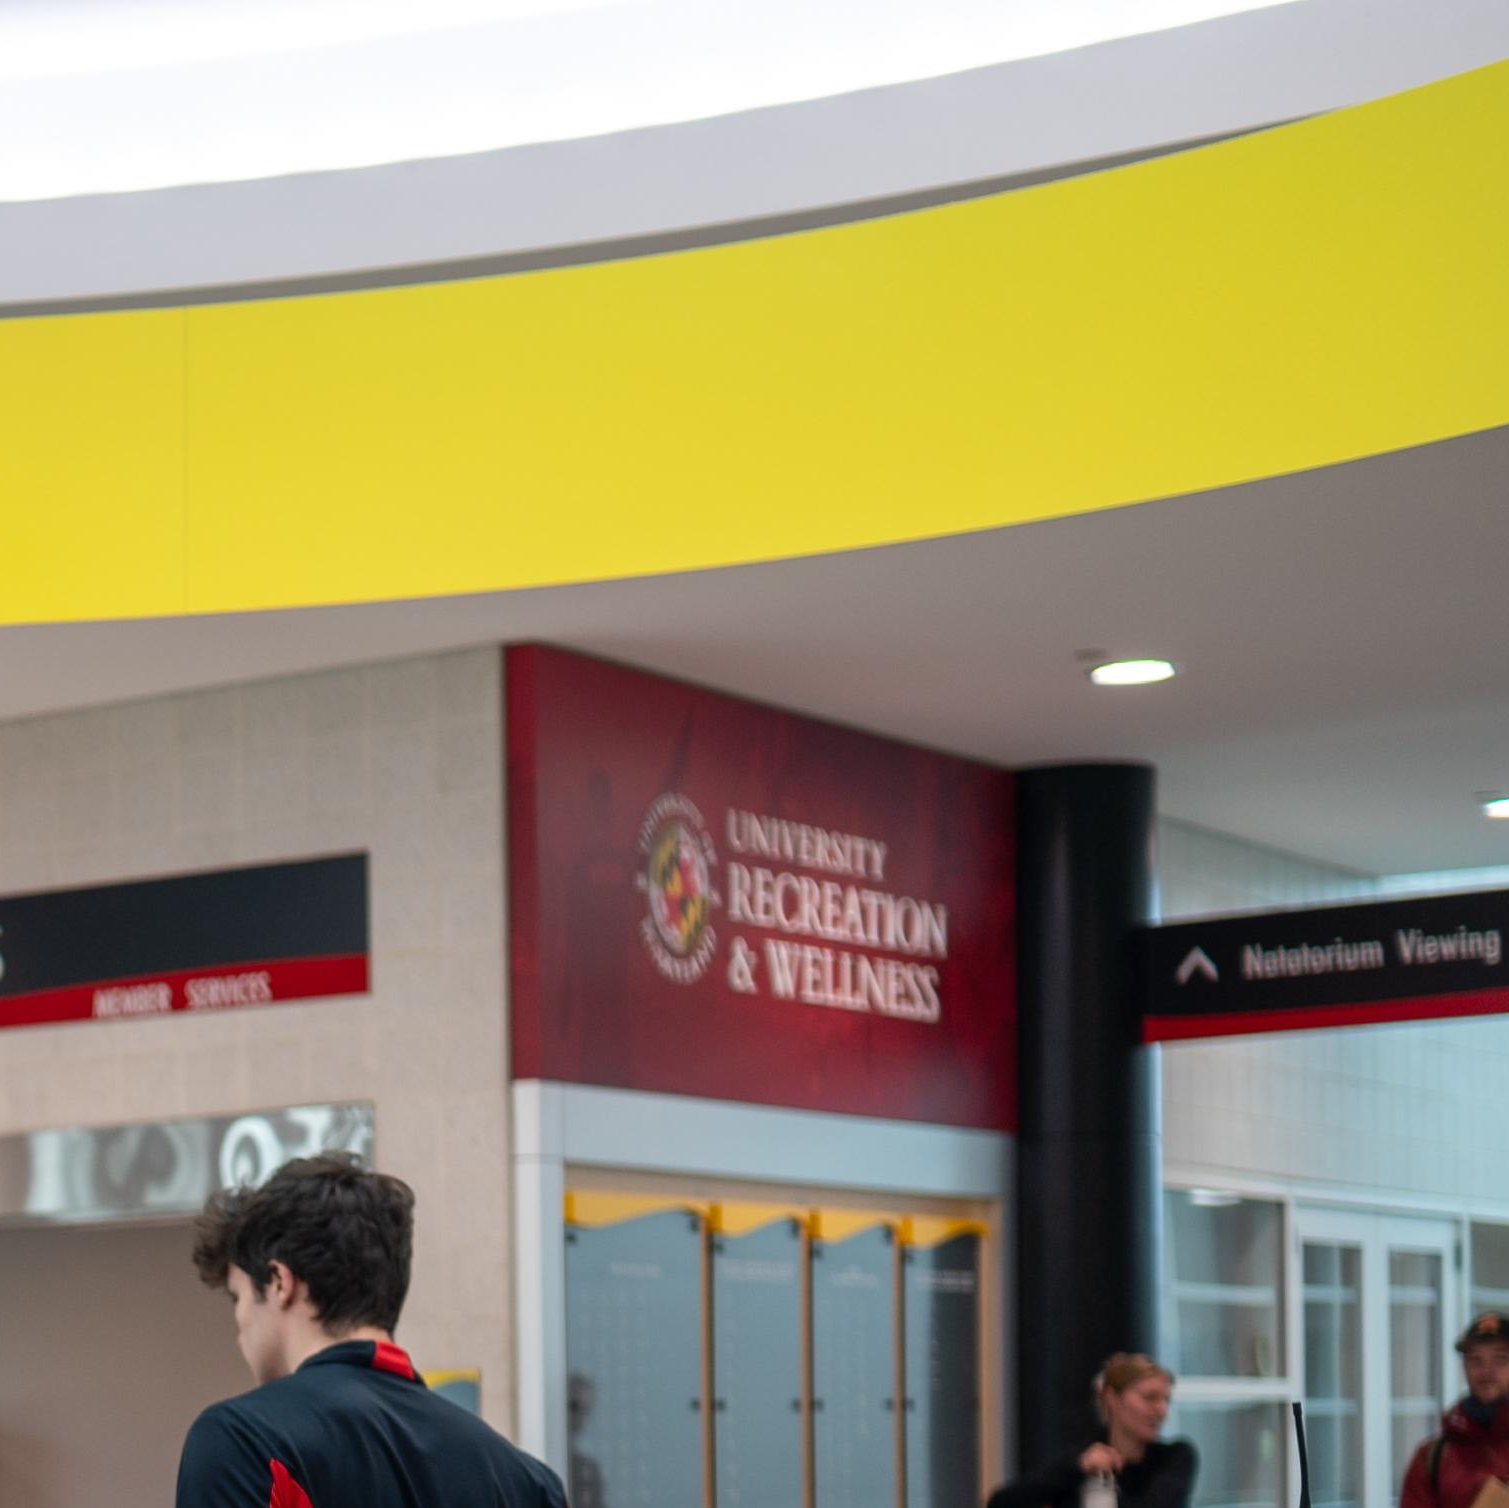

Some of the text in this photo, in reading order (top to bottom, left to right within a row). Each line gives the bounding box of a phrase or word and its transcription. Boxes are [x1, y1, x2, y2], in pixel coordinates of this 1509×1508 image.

[726, 808, 887, 880] UNIVERSITY
[726, 862, 948, 958] RECREATION
[727, 936, 942, 1024] & WELLNESS
[1242, 925, 1501, 980] Natatorium Viewing
[93, 970, 273, 1018] MEMBER SERVICES
